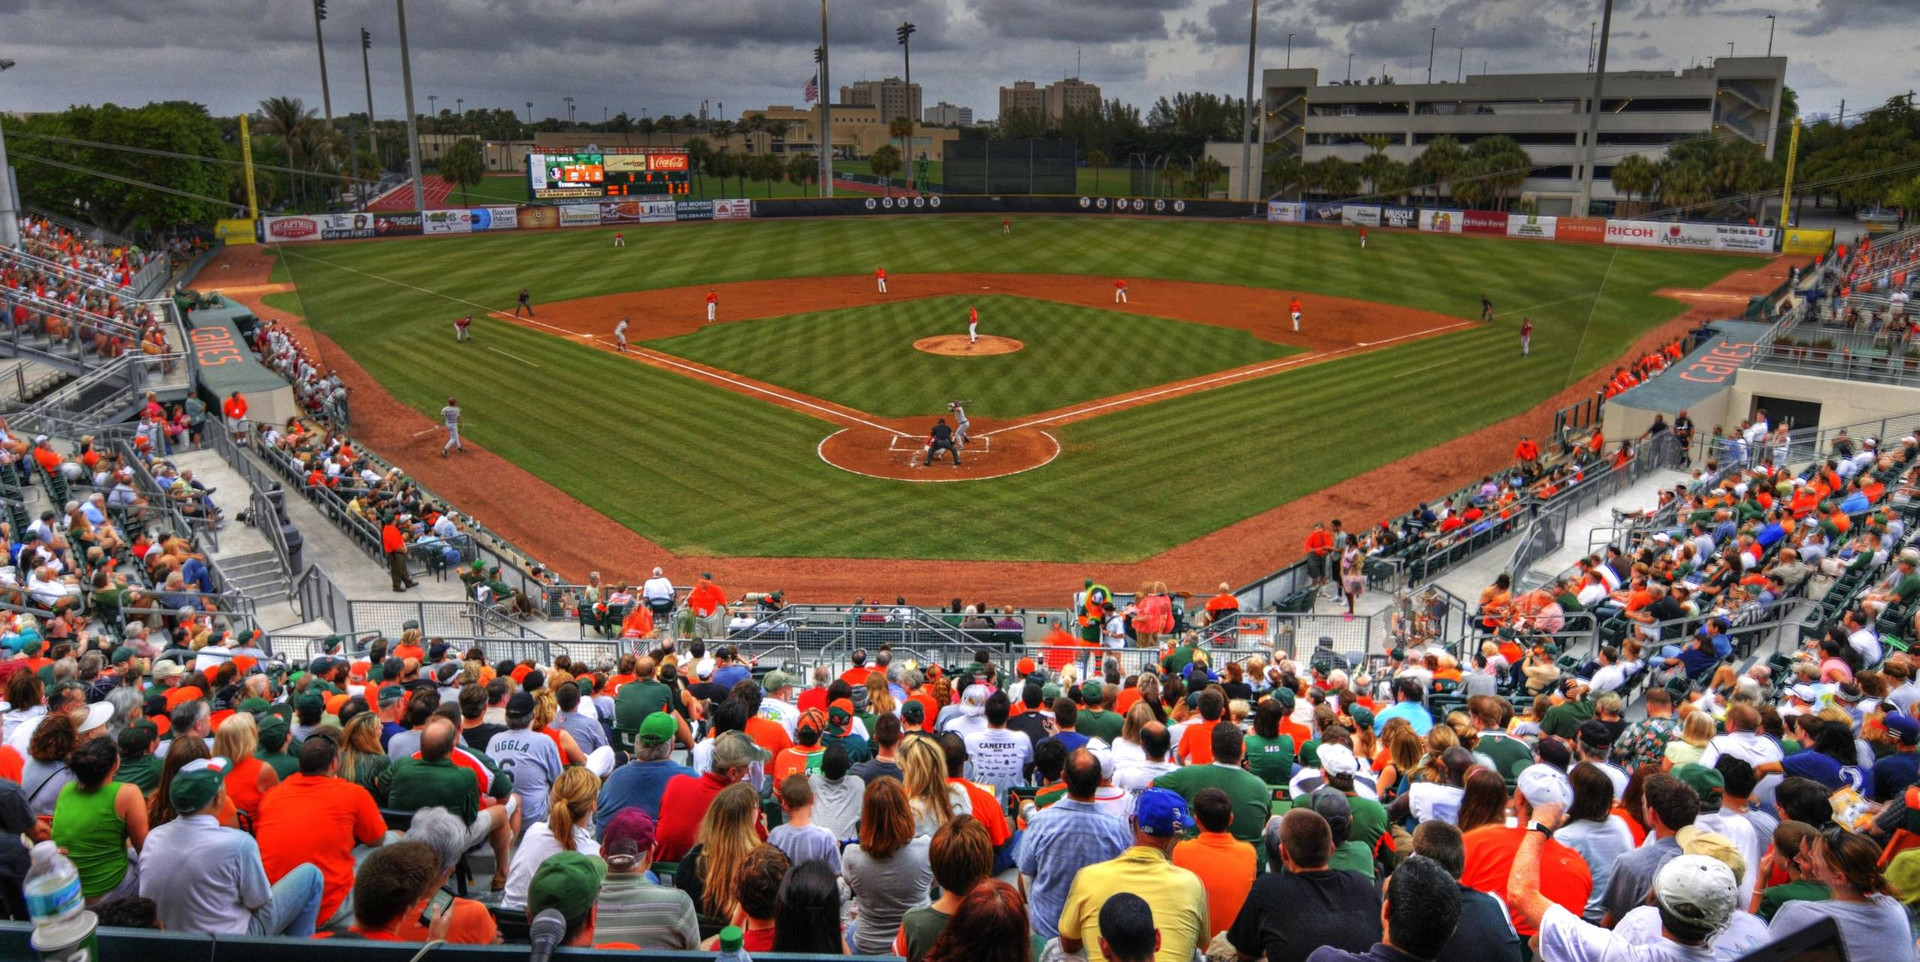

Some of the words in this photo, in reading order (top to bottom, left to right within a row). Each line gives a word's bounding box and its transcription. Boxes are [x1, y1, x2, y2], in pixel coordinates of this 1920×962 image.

[1385, 209, 1414, 219] MUSCLE
[1608, 226, 1654, 237] RICOH
[495, 740, 530, 753] UGGLA
